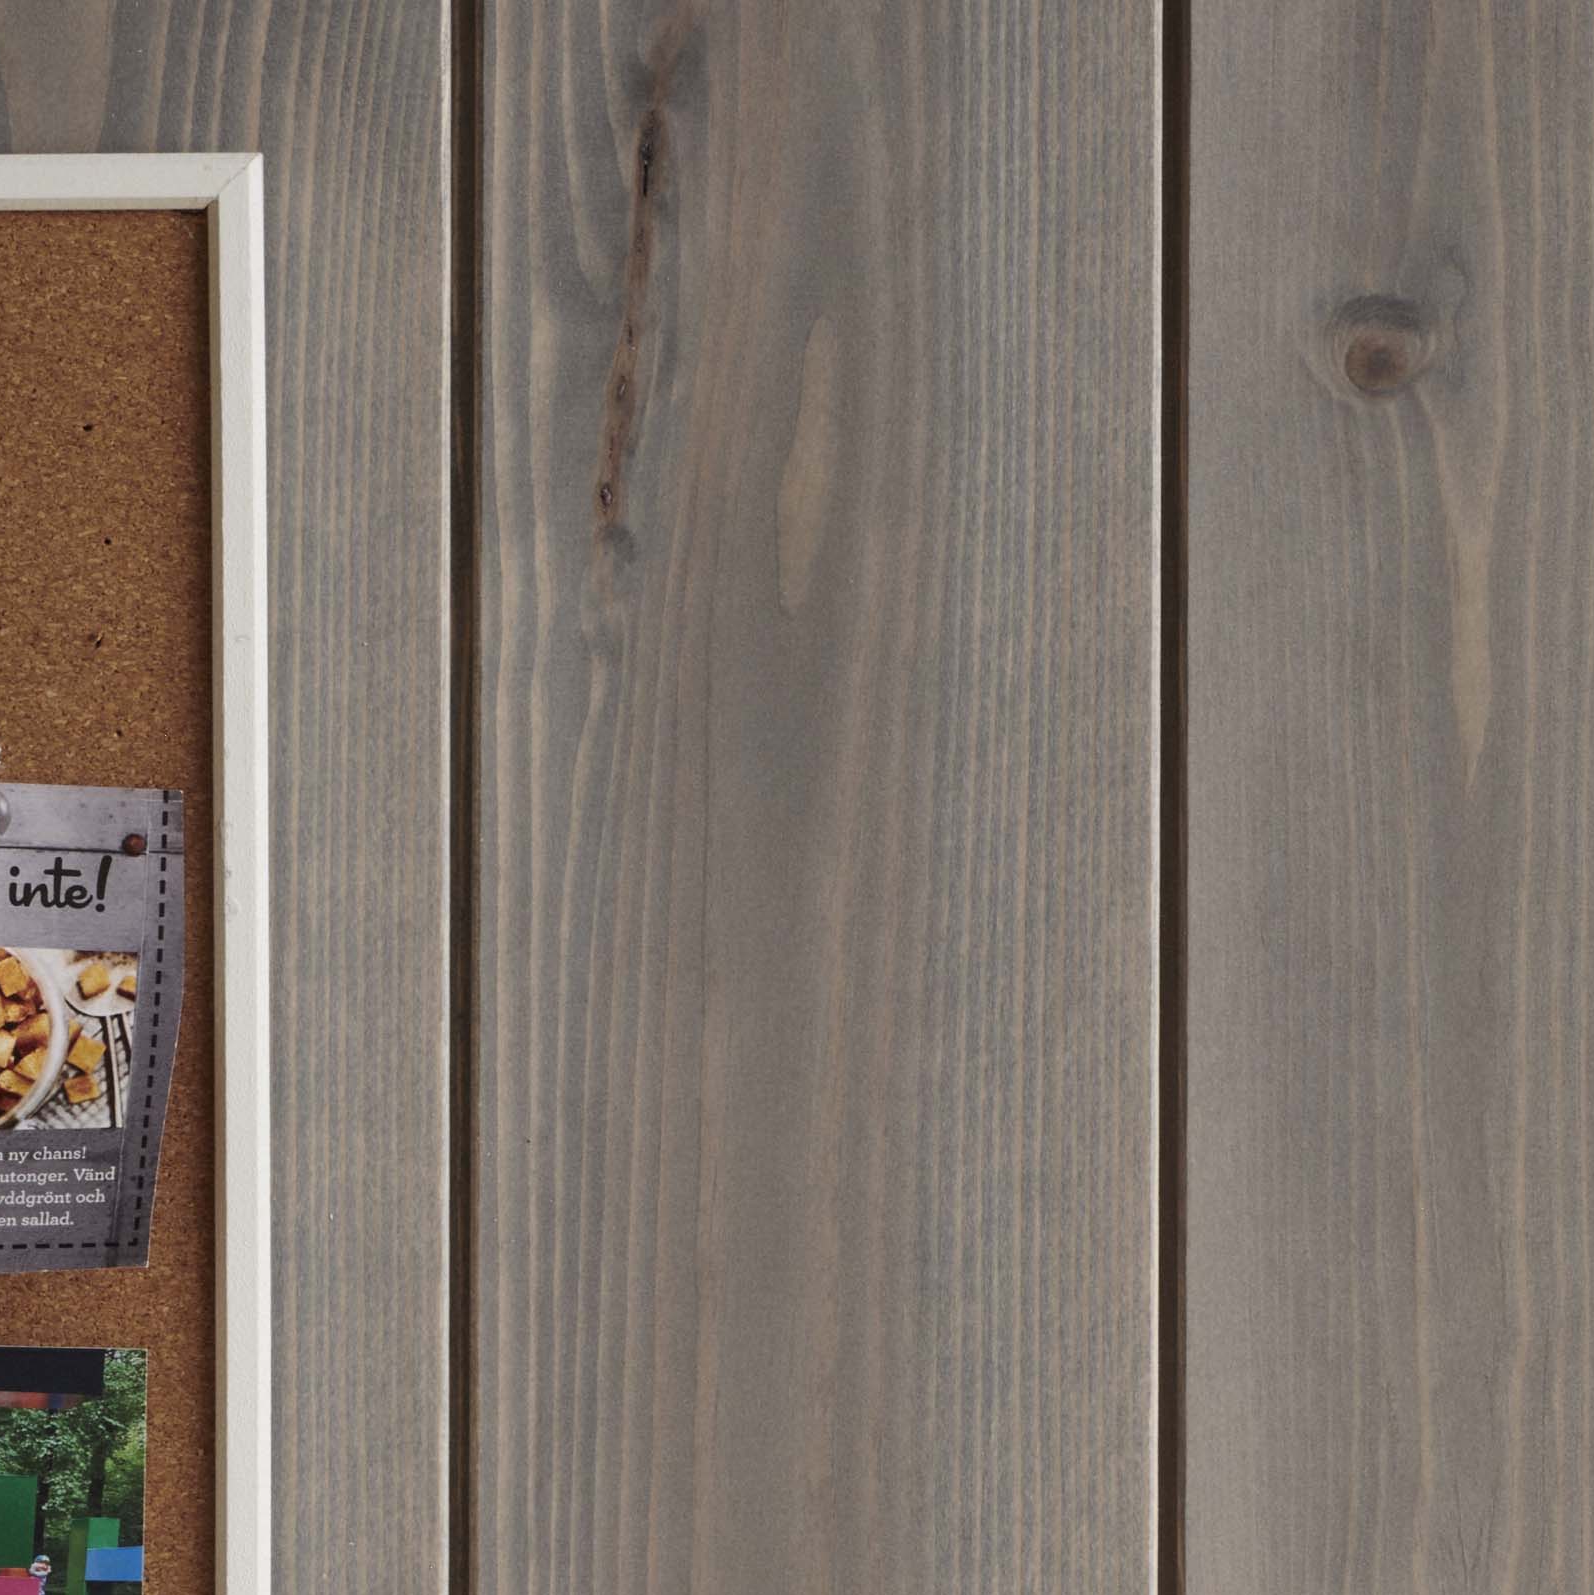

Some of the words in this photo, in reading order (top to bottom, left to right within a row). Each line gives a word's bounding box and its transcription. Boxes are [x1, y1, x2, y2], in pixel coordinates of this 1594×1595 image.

[8, 854, 112, 913] inte!
[8, 1148, 29, 1166] ny
[34, 1145, 87, 1162] chans!
[74, 1166, 116, 1182] Vänd
[21, 1210, 74, 1227] sallad.
